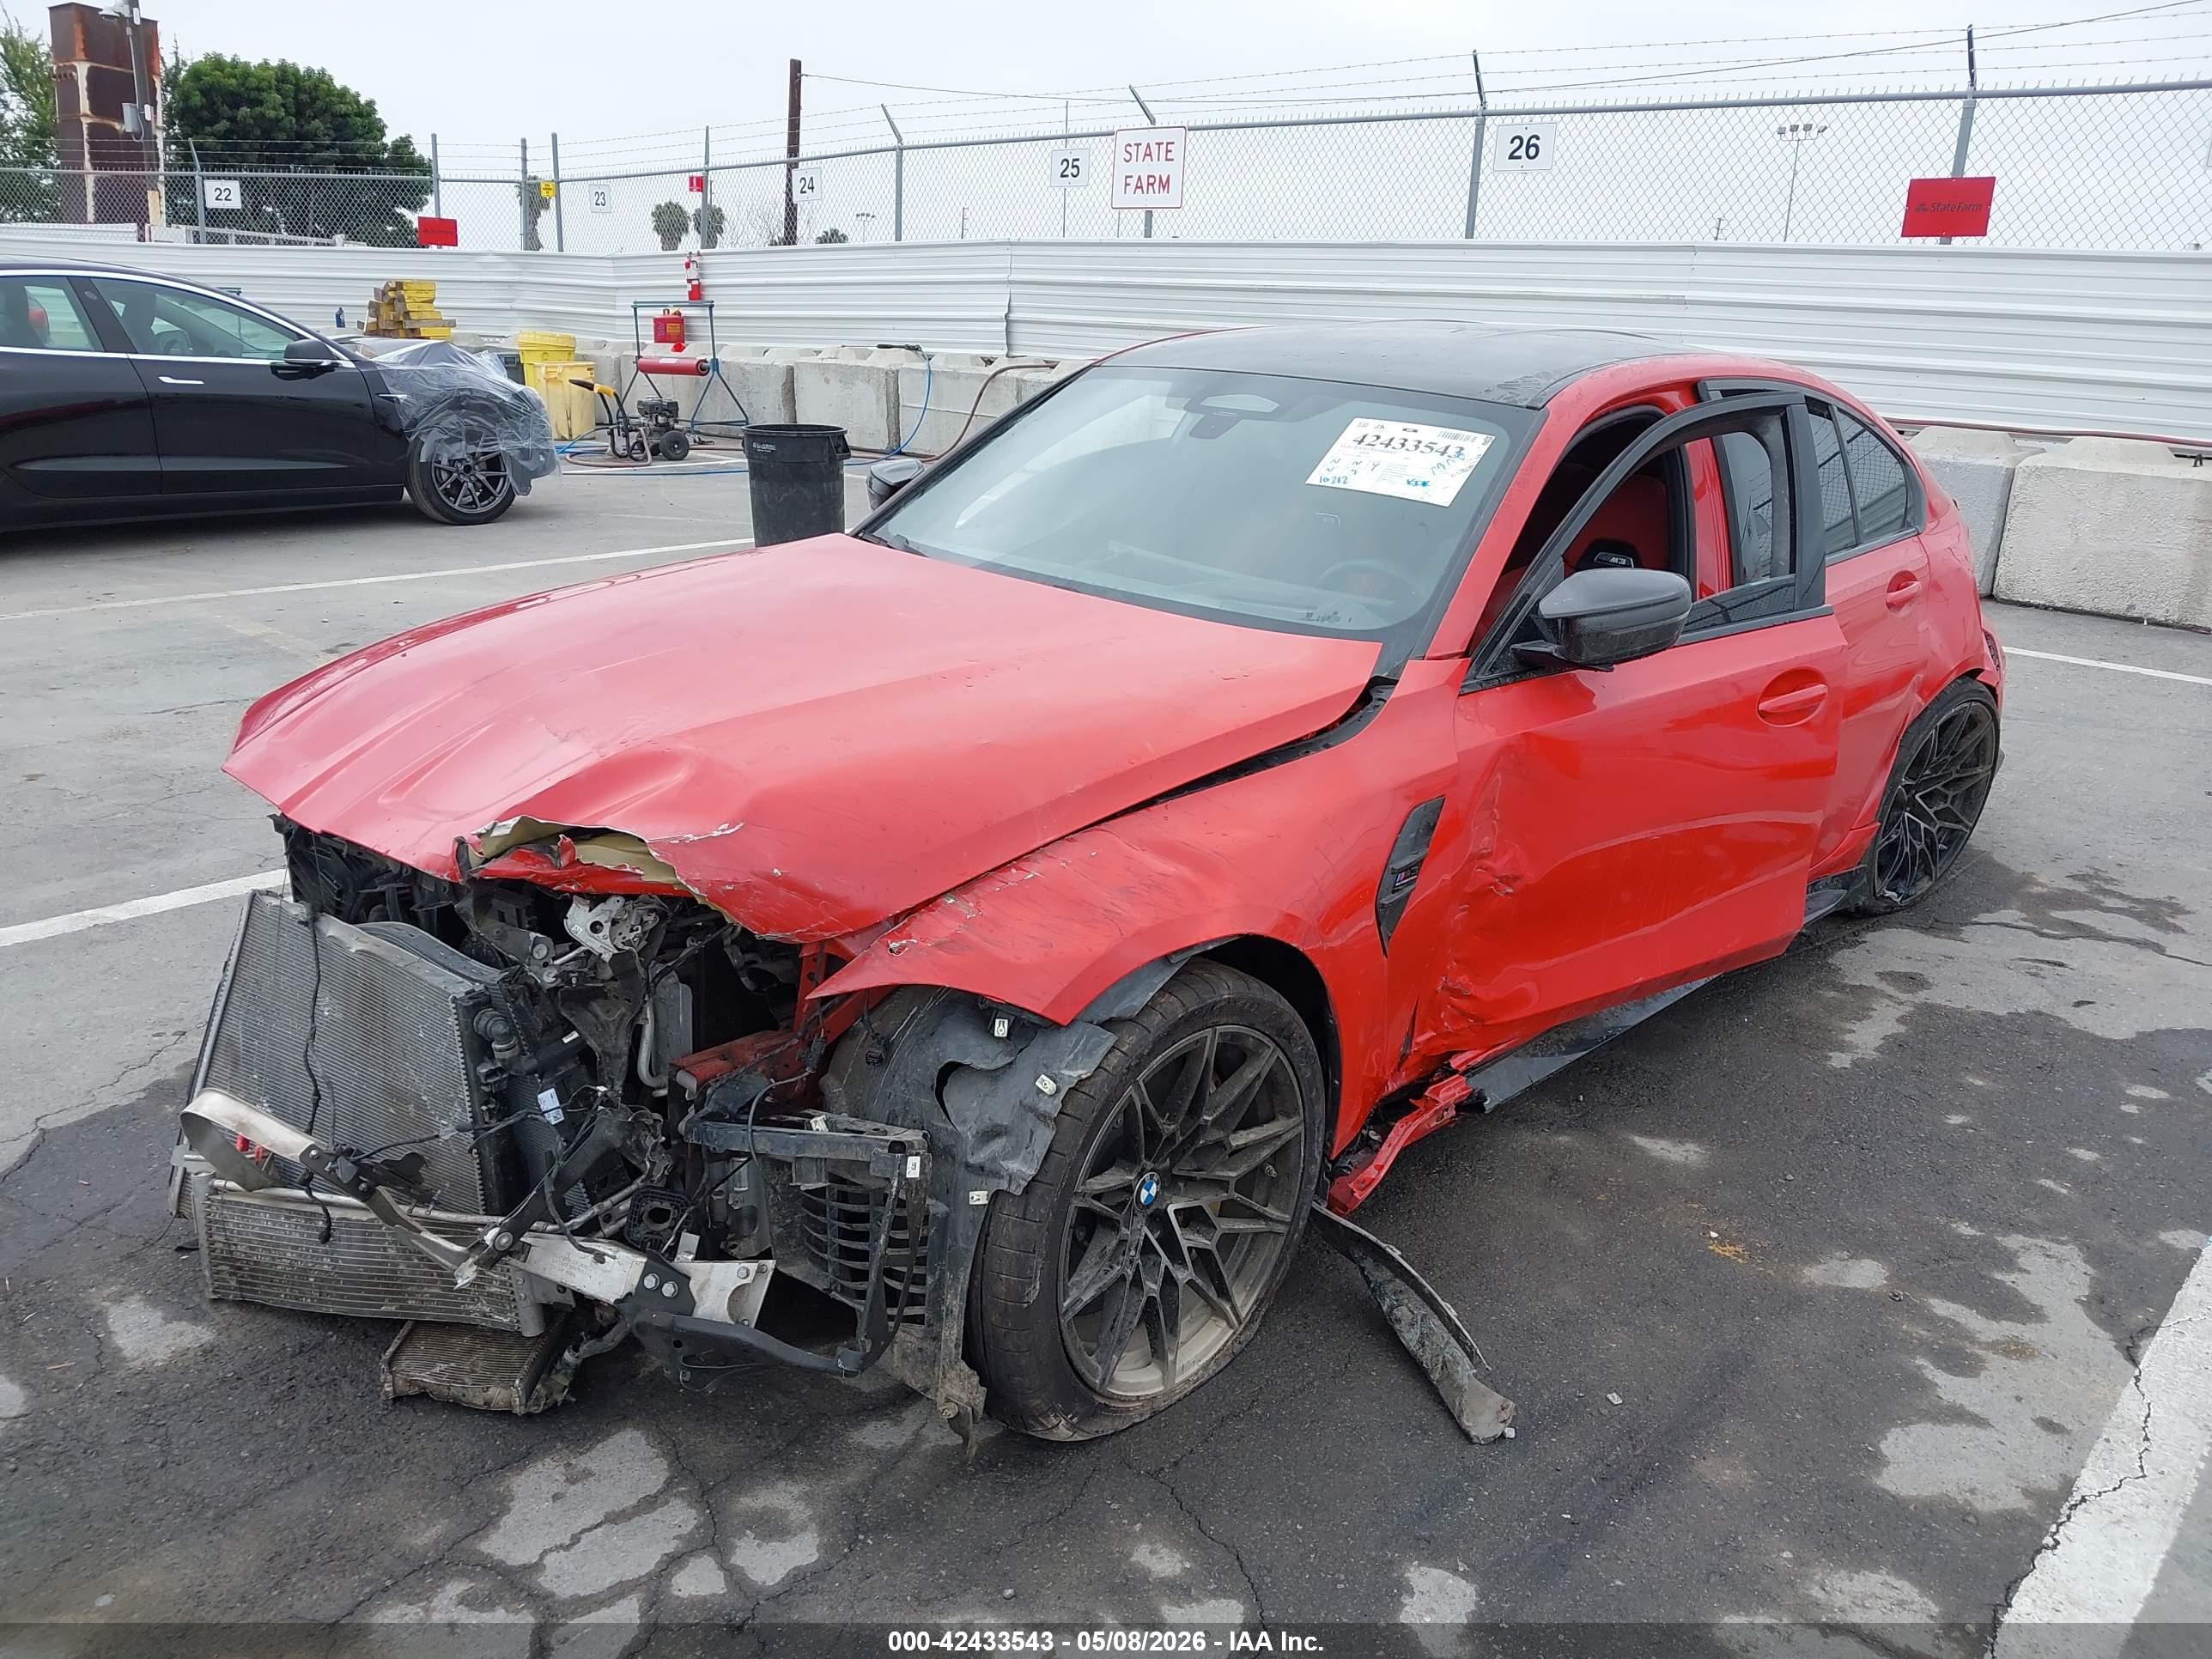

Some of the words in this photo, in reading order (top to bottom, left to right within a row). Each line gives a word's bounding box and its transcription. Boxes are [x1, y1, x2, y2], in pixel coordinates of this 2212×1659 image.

[1123, 141, 1175, 163] STATE
[1508, 134, 1540, 161] 26
[1060, 157, 1080, 179] 25
[214, 187, 233, 202] 22
[799, 176, 815, 194] 24
[1123, 173, 1170, 196] FARM
[594, 191, 606, 207] 23
[1352, 433, 1465, 459] 42433543
